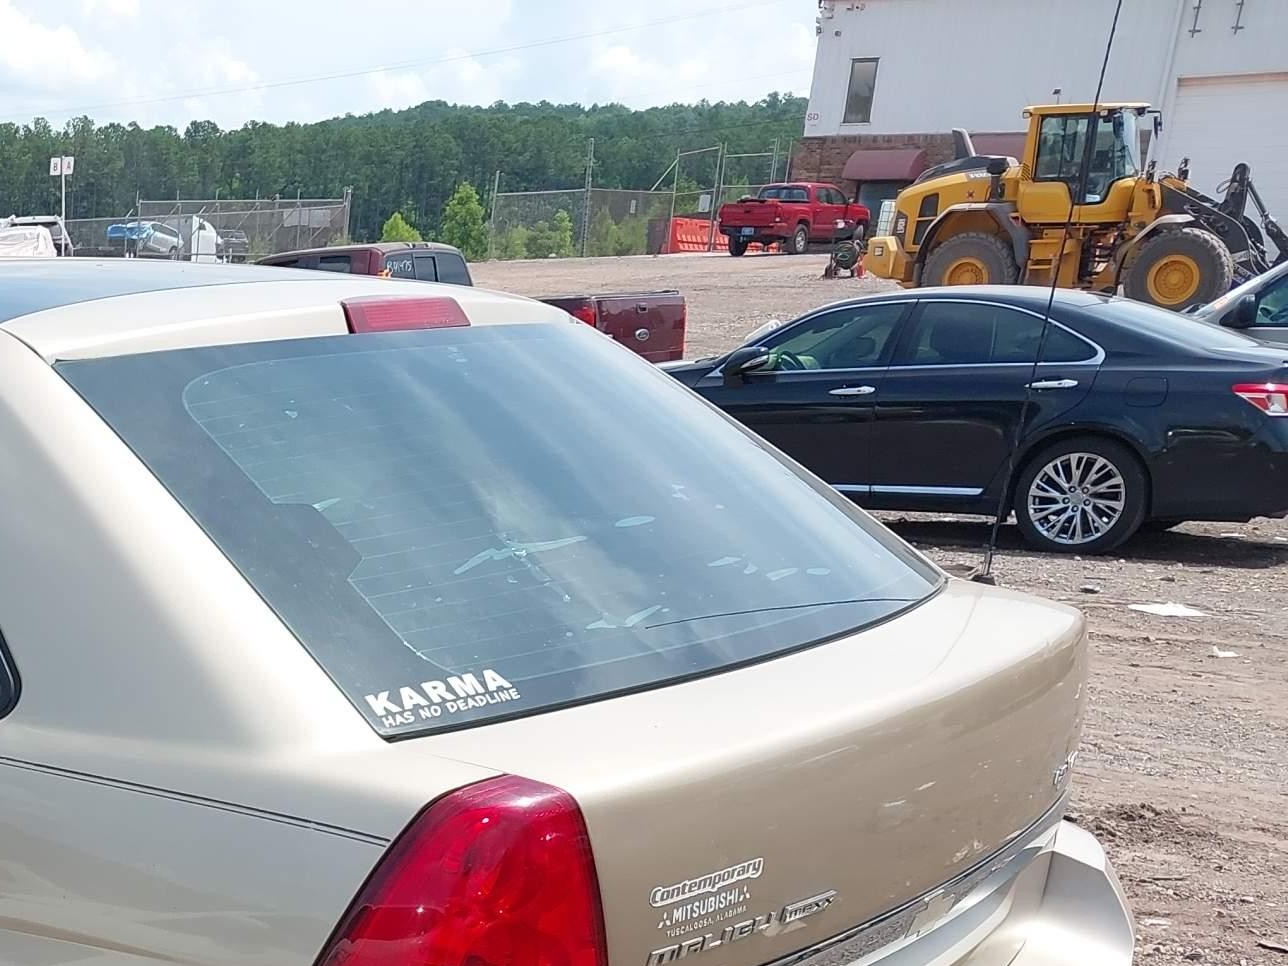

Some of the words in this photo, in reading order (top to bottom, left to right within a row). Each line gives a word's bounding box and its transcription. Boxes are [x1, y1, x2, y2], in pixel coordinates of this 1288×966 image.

[365, 669, 512, 716] KARMA
[381, 711, 415, 728] HAS
[418, 706, 442, 720] NO
[445, 688, 521, 713] DEADLINE
[651, 858, 763, 906] Contemporary
[672, 888, 740, 924] MITSUBISHI
[715, 905, 748, 922] ALABAMA
